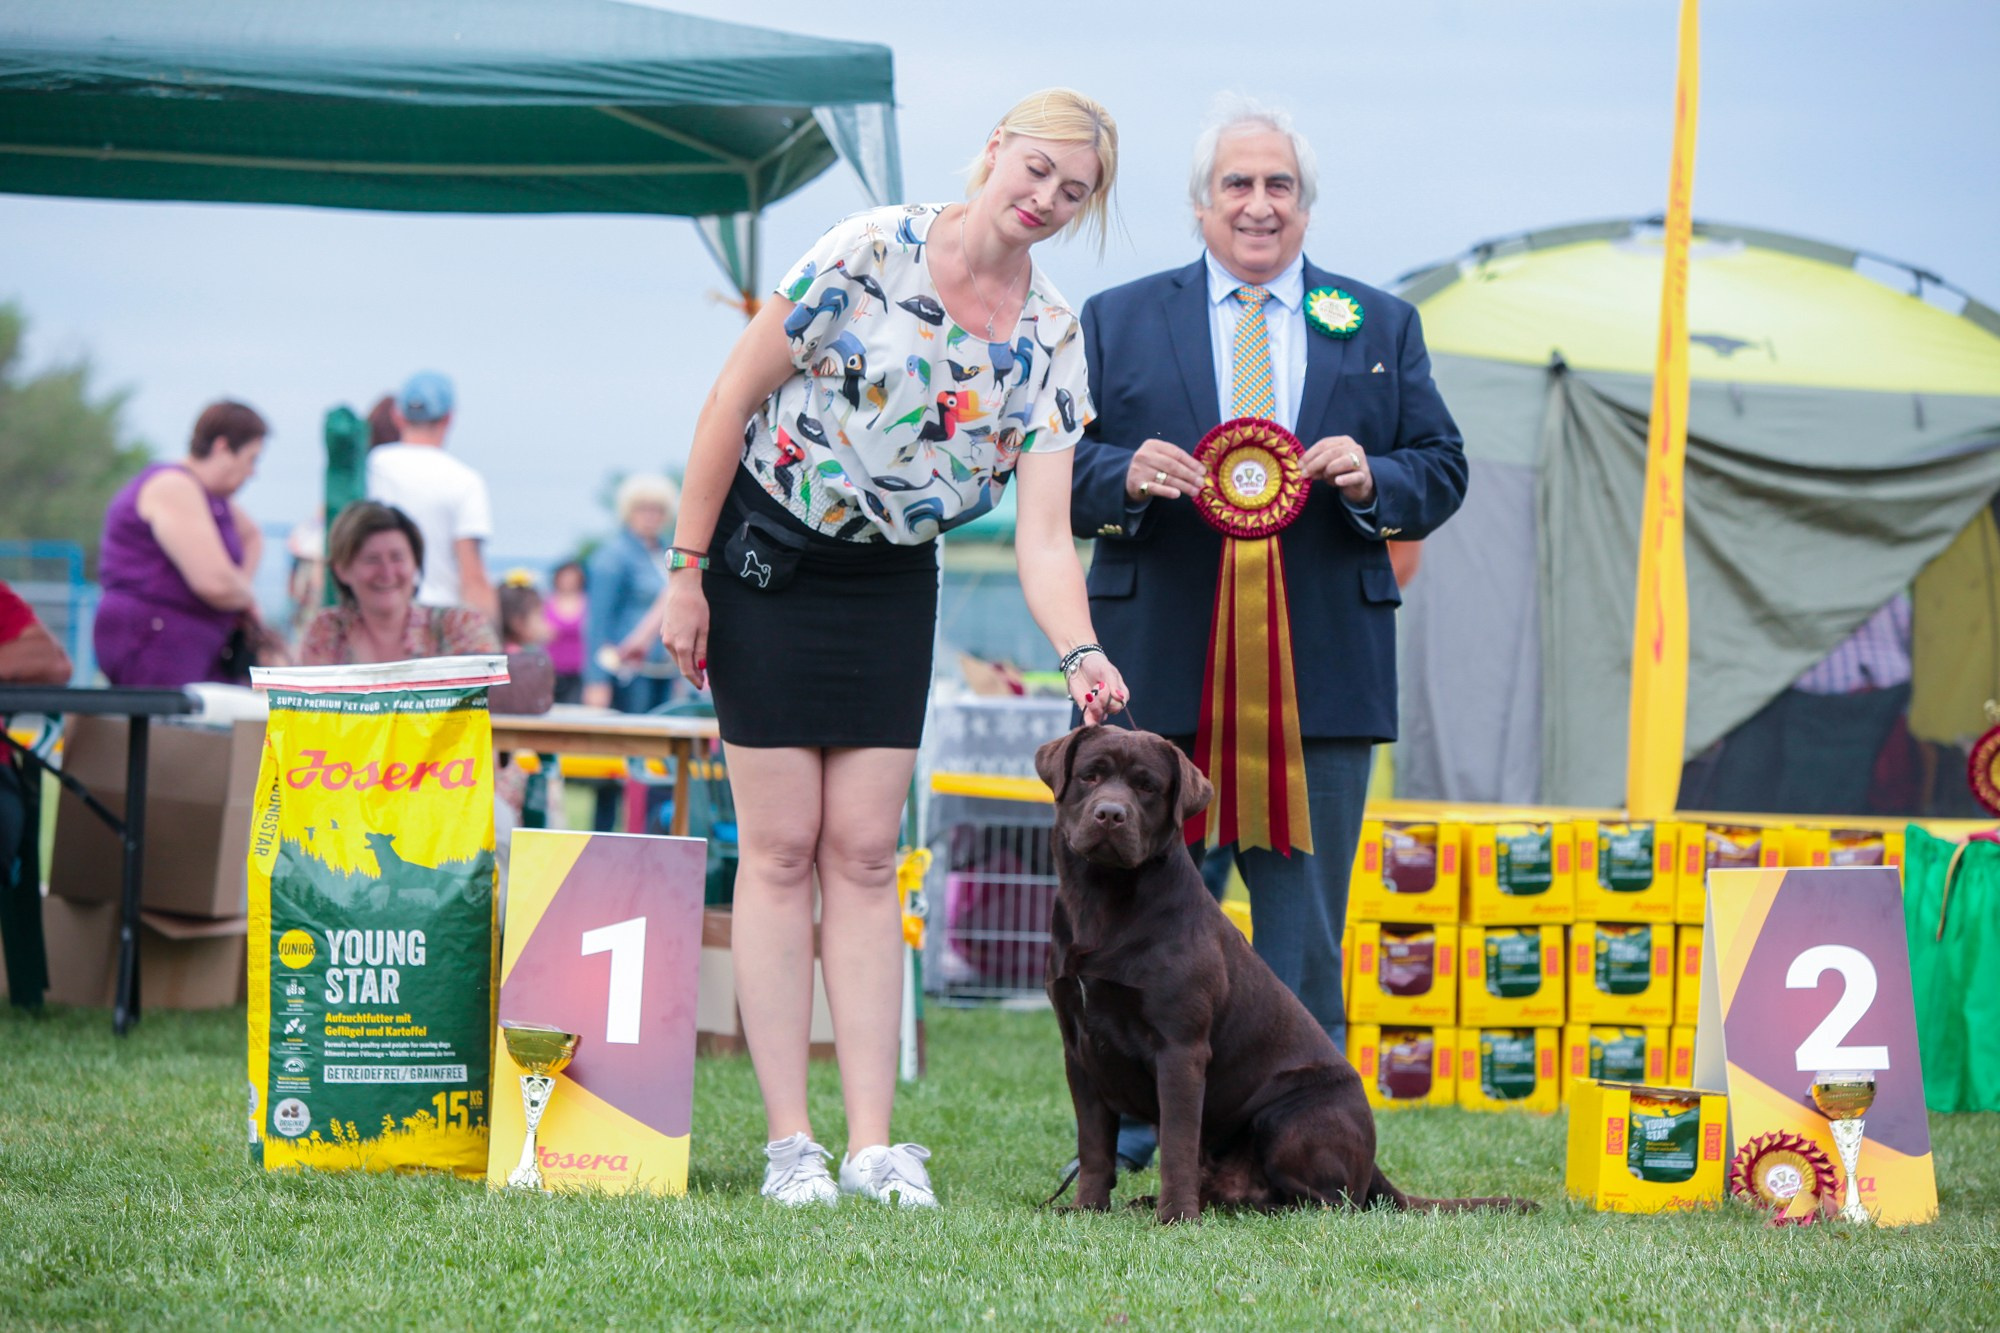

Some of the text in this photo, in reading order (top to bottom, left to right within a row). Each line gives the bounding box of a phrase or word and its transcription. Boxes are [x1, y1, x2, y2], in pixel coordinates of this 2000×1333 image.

[276, 695, 380, 712] SUPER PREMIUM PET FOOD
[415, 699, 425, 709] IN
[425, 696, 463, 708] GERMANY
[286, 750, 477, 792] Josera
[279, 942, 316, 956] JUNIOR
[325, 929, 426, 966] YOUNG
[325, 967, 401, 1004] STAR
[581, 916, 647, 1044] 1
[325, 1012, 412, 1024] Aufzuchtfutter mit
[1785, 944, 1890, 1071] 2
[324, 1025, 427, 1038] Geflügel und Kartoffel
[432, 1090, 483, 1132] 15 KG
